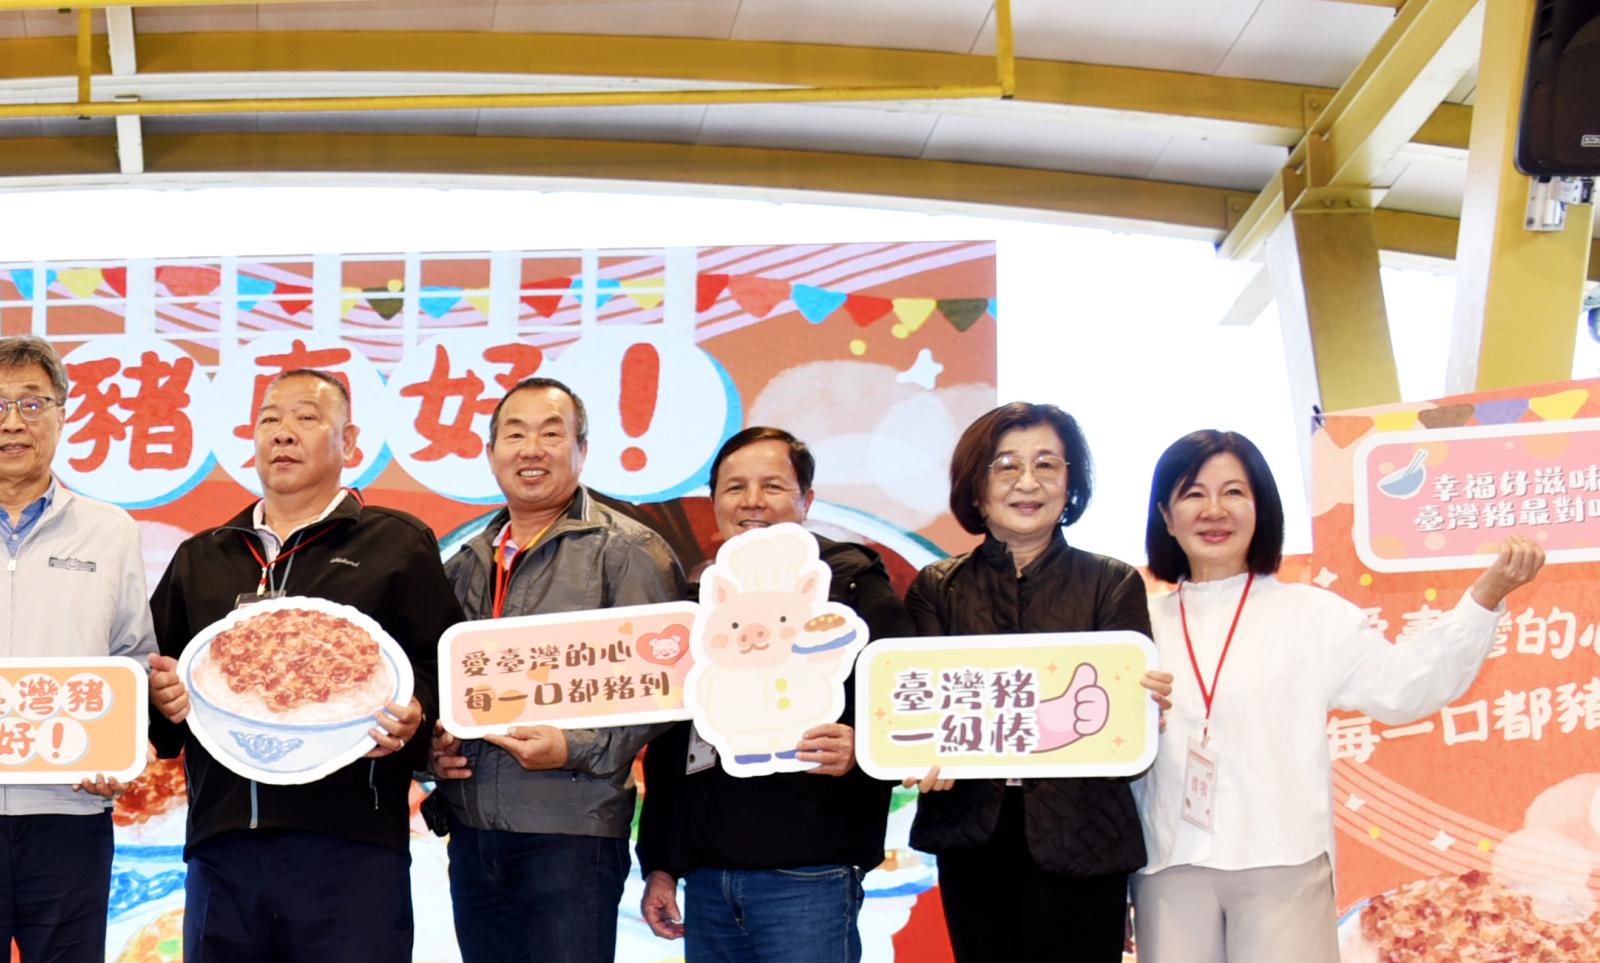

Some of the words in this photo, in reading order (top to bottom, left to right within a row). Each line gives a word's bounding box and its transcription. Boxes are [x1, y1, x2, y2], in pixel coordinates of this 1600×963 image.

[1431, 464, 1600, 501] 幸福好滋味
[460, 641, 632, 677] 愛臺灣的心
[462, 671, 670, 713] 每一口都豬到
[893, 669, 1036, 712] 臺灣豬
[891, 712, 1036, 753] 一級棒
